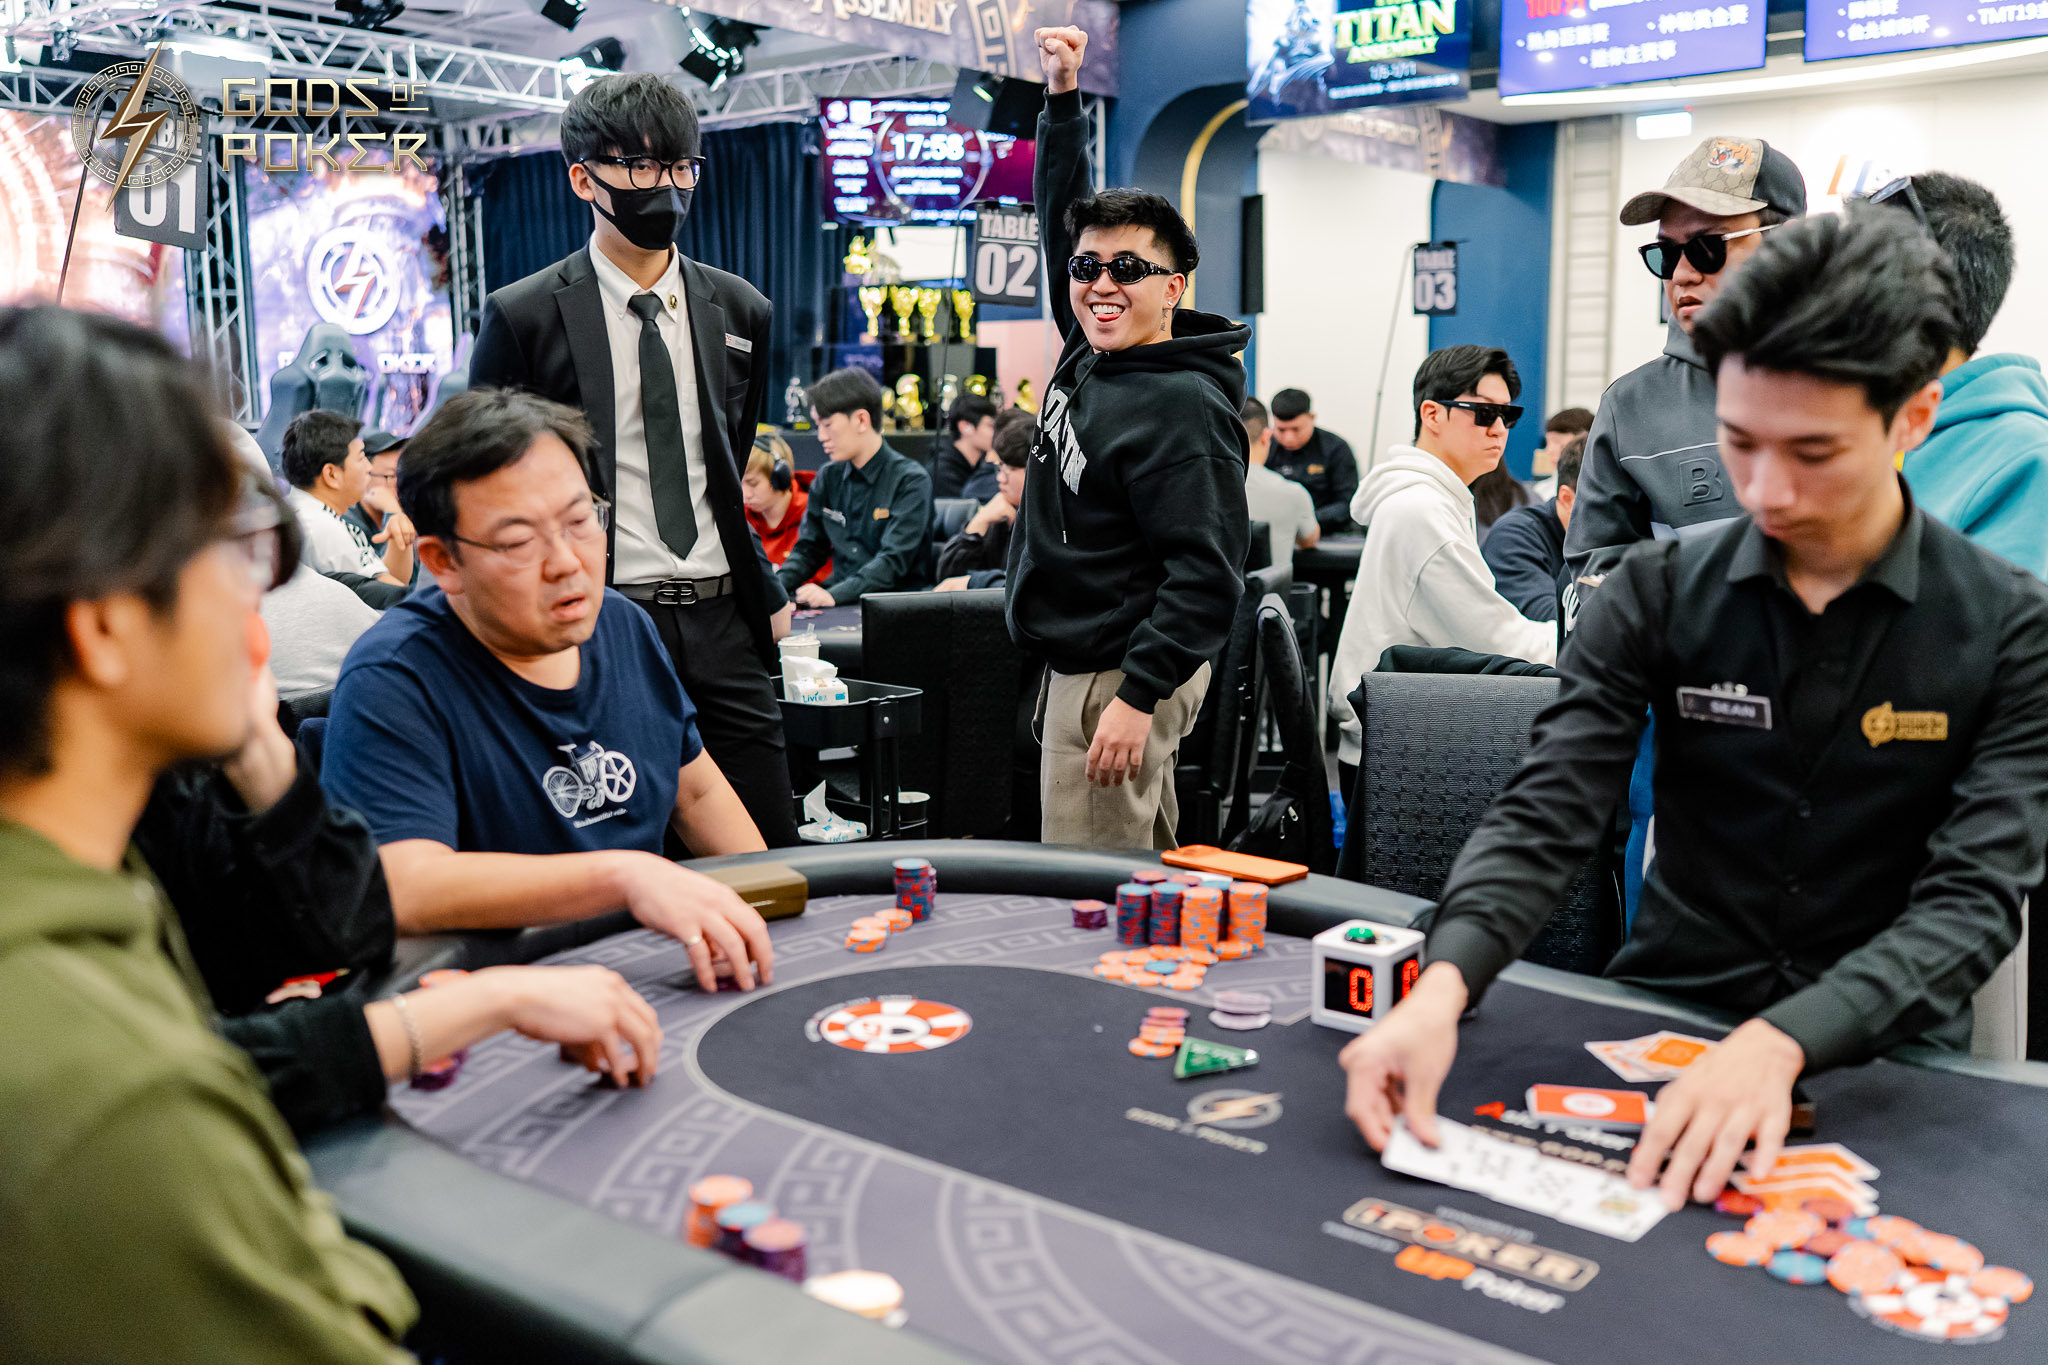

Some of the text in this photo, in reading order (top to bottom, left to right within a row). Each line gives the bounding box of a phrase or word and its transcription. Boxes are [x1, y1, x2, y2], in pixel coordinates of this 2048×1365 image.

[1335, 0, 1456, 49] TITAN
[890, 132, 965, 161] 17:58
[978, 212, 1040, 241] TABLE
[975, 242, 1038, 297] 02
[1414, 272, 1457, 311] 03
[1679, 457, 1723, 507] B
[1348, 966, 1374, 1012] 0
